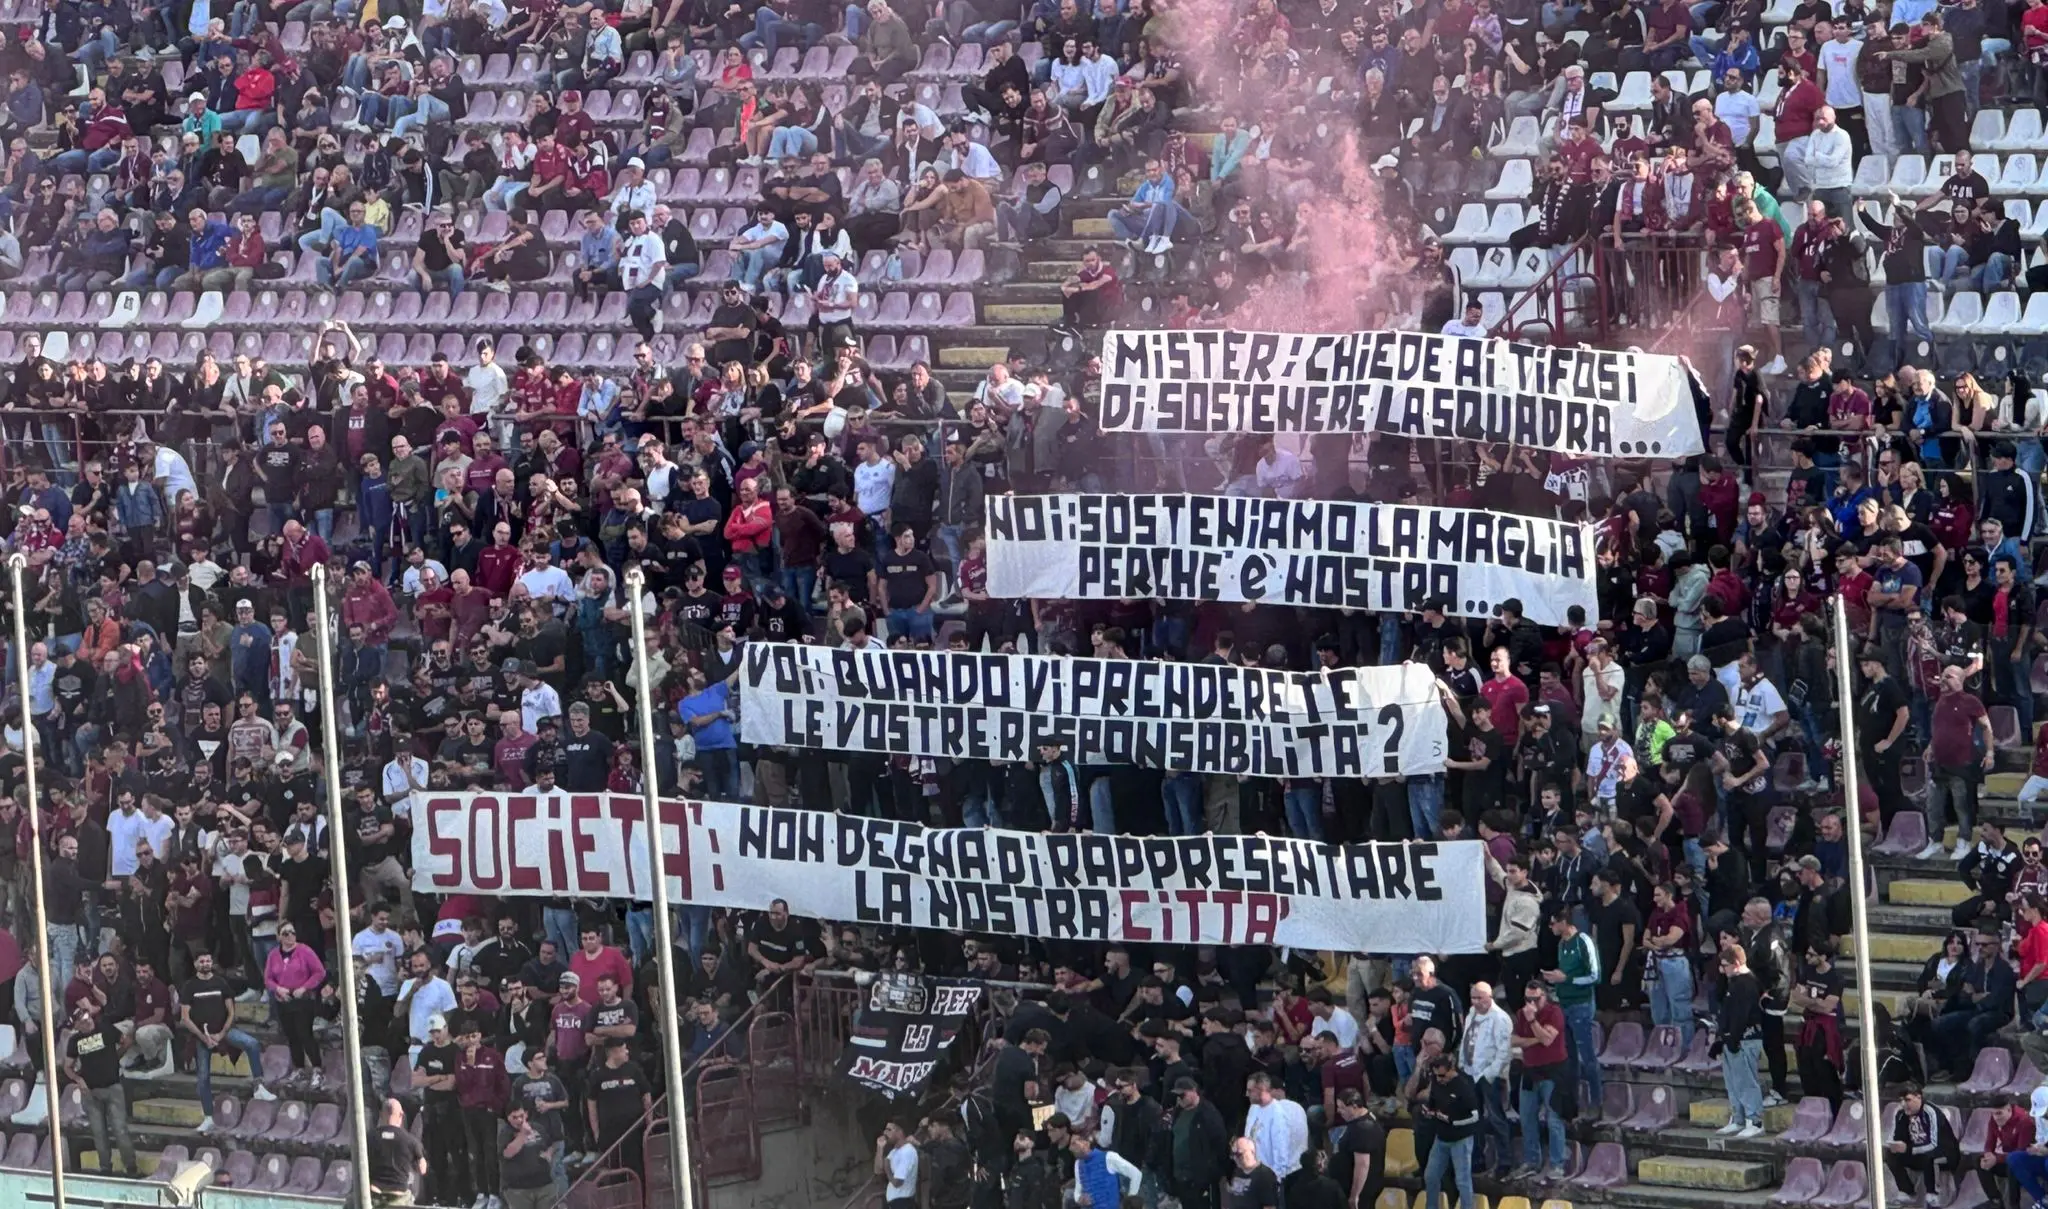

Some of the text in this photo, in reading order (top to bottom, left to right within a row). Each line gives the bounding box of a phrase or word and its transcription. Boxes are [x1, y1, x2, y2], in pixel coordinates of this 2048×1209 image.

[1157, 383, 1370, 432] SOSTENERE
[1375, 386, 1425, 435] LA
[1369, 507, 1419, 558] LA
[832, 649, 1011, 708] QUANDO
[1072, 661, 1358, 723] PRENDERETE
[783, 699, 823, 747] LE
[836, 701, 989, 757] VOSTRE
[739, 807, 825, 863] NON
[836, 812, 990, 880] DEGNA
[1046, 834, 1443, 901] RAPPRESENTARE
[855, 870, 912, 924] LA
[926, 878, 1109, 939] NOSTRA
[931, 986, 981, 1016] PER
[902, 1024, 934, 1053] LA
